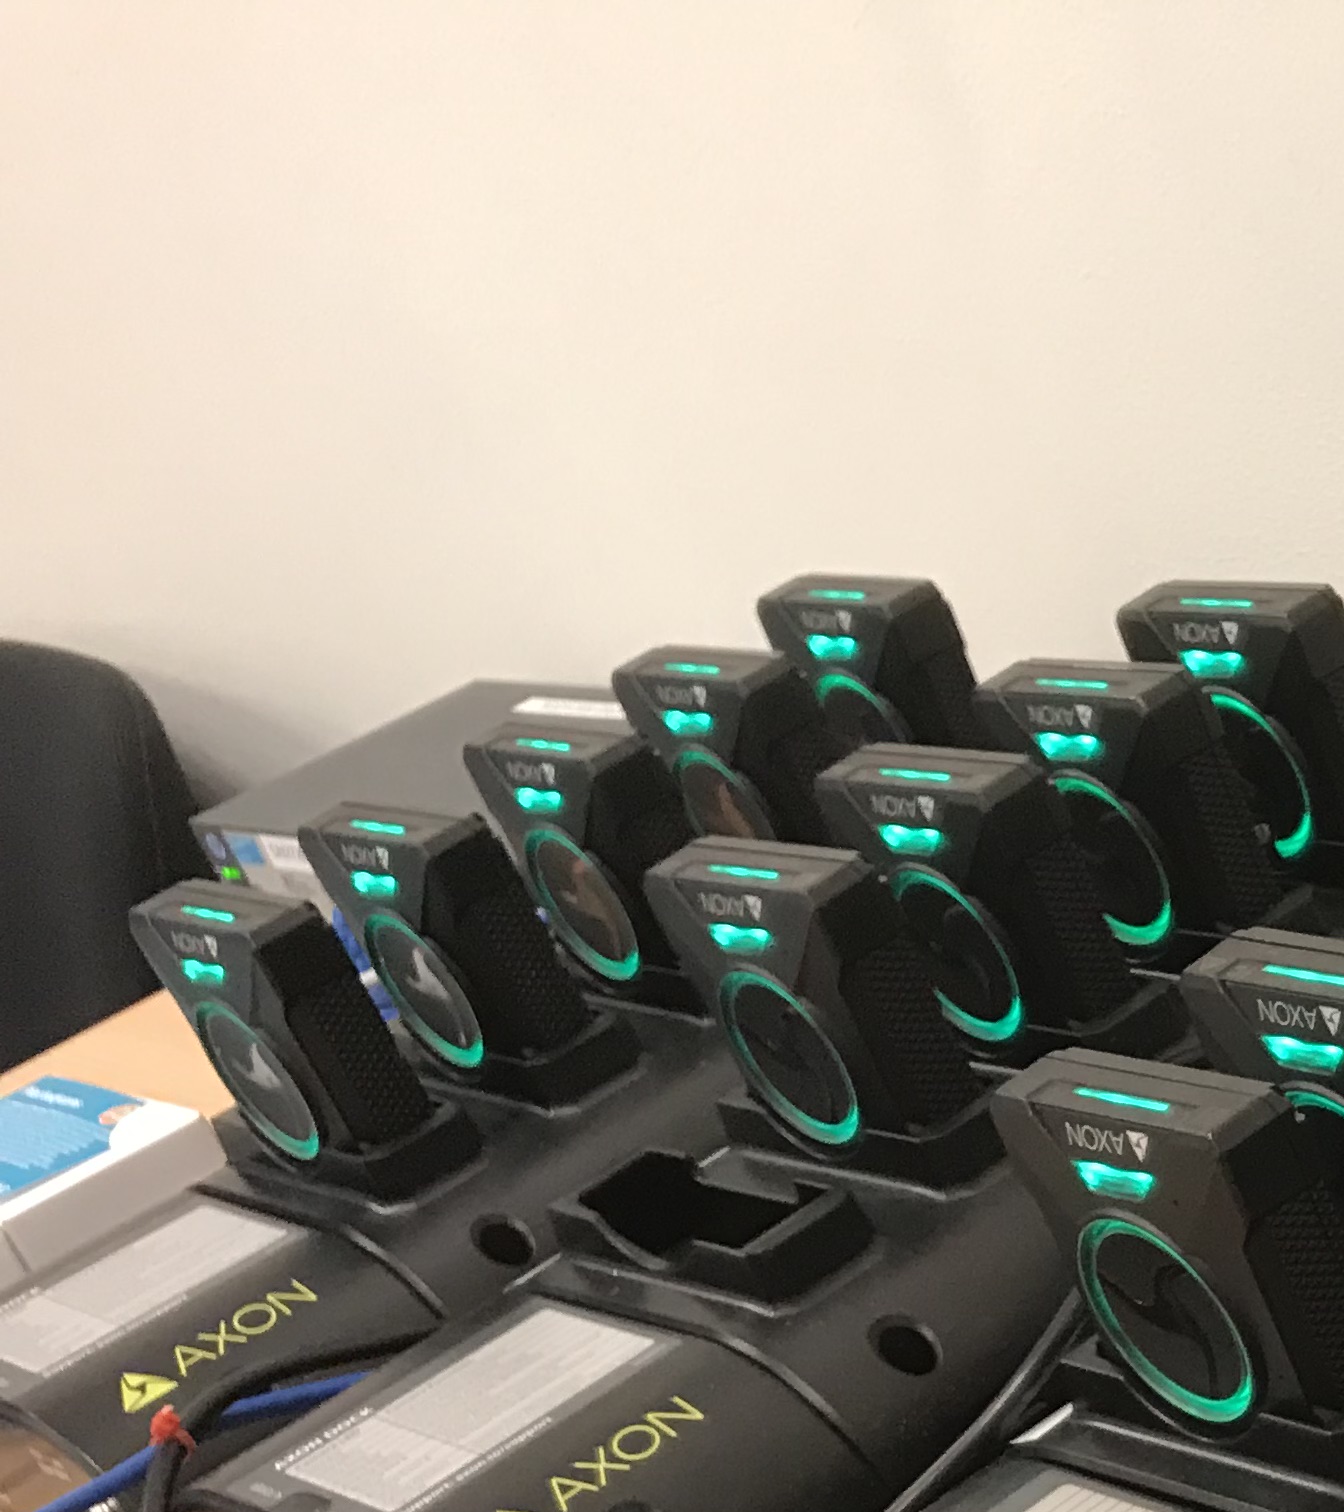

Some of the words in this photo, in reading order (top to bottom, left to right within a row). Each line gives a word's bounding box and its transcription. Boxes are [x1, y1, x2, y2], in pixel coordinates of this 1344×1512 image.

[1258, 998, 1316, 1029] AXON
[1066, 1121, 1125, 1154] AXON
[174, 1277, 319, 1377] AXON
